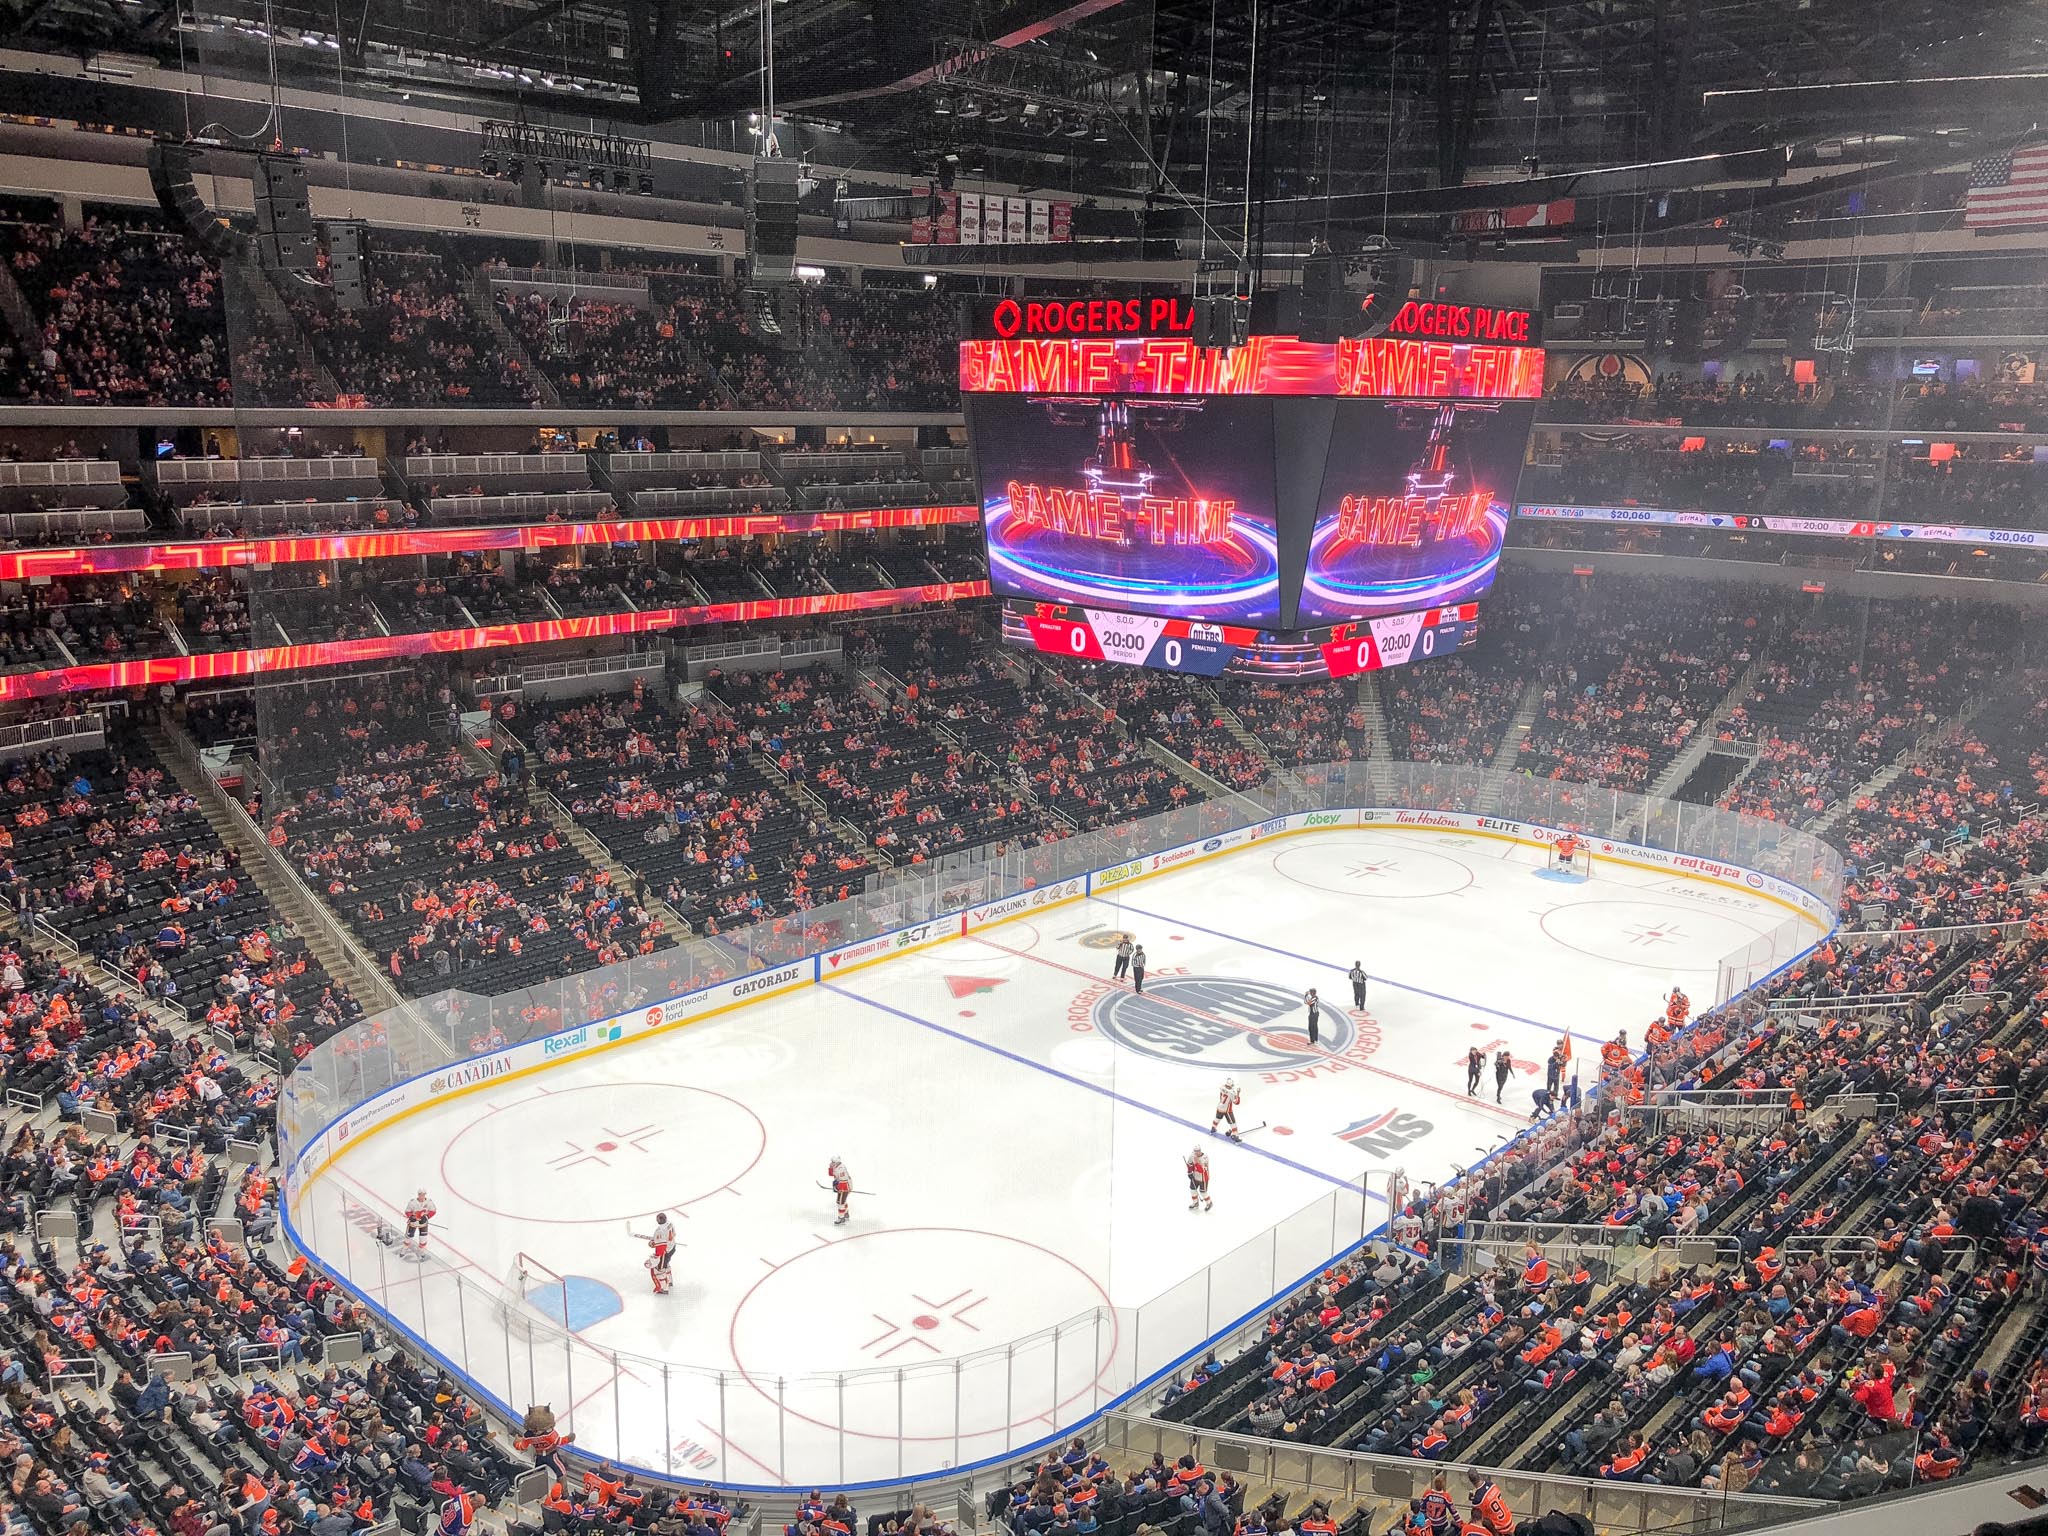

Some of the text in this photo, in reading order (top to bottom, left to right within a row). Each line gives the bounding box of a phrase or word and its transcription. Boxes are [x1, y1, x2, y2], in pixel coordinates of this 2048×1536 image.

[1027, 300, 1141, 333] ROGERS
[1474, 308, 1530, 341] PLACE
[1334, 338, 1451, 396] GAME
[1007, 480, 1124, 541] GAME
[1144, 497, 1235, 545] TIME
[1338, 495, 1424, 545] GAME
[1521, 507, 1558, 516] RE/MAX
[1610, 510, 1651, 521] $20,060
[1751, 517, 1759, 528] 0
[1803, 521, 1829, 532] 20:00
[1860, 524, 1868, 534] 0
[1924, 528, 1953, 537] RE/MAX
[1989, 530, 2034, 543] $20,060
[1095, 612, 1100, 620] 0
[1153, 620, 1159, 628] 0
[1071, 627, 1086, 652] 0
[1103, 631, 1145, 651] 20:00
[1191, 644, 1216, 653] PENALTIES
[1381, 633, 1411, 653] 20:00
[1423, 629, 1434, 655] 0
[1113, 650, 1132, 659] PERIOD
[1165, 640, 1182, 667] 0
[1357, 641, 1369, 668] 0
[1303, 813, 1341, 826] Sobeys
[1395, 811, 1461, 828] Tim Hortons
[1483, 819, 1520, 833] ELITE
[1161, 847, 1196, 865] Scotiabank
[1615, 846, 1668, 862] AIR CANADA
[1100, 861, 1142, 885] PIZZA 73
[1749, 875, 1761, 885] Esso
[1777, 885, 1799, 902] Synergy
[989, 902, 1008, 918] JACK
[897, 925, 930, 946] ACT
[843, 938, 890, 961] CANADIAN TIRE
[732, 967, 799, 997] GATORADE
[665, 991, 709, 1013] kentwood
[1067, 984, 1111, 1021] ROGERS
[647, 1009, 683, 1026] go ford
[544, 1027, 588, 1055] Rexall
[1258, 1019, 1382, 1084] ROGERS PLACE
[466, 1056, 492, 1068] MOLSON
[447, 1057, 512, 1089] CANADIAN
[350, 1093, 406, 1129] WorleyParsonsCord
[1427, 1502, 1446, 1517] 97
